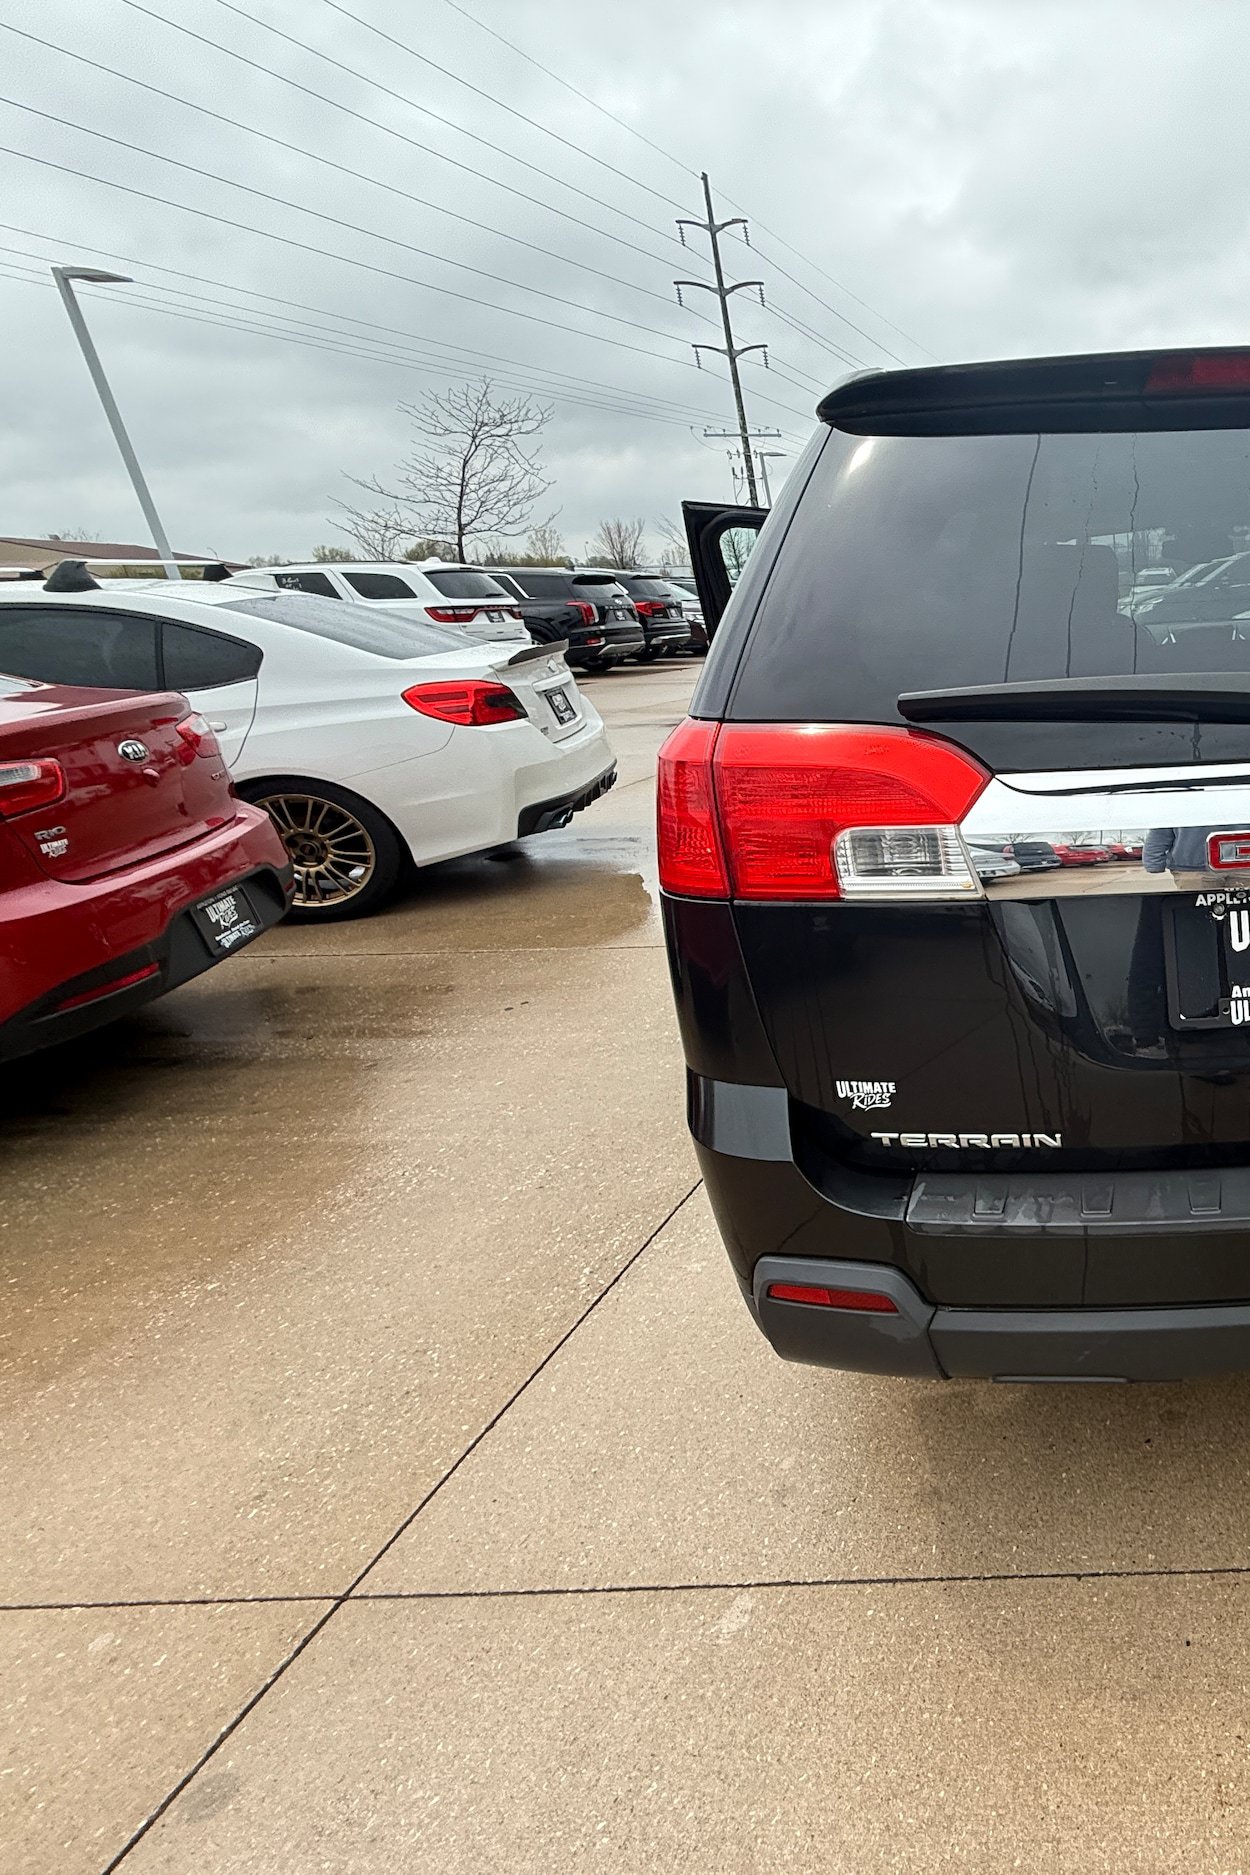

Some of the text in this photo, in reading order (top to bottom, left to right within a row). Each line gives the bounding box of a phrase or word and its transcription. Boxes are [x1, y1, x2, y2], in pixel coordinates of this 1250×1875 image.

[206, 896, 236, 923] ULTIMATE
[836, 1080, 897, 1099] ULTIMATE
[871, 1132, 1062, 1149] TERRAIN
